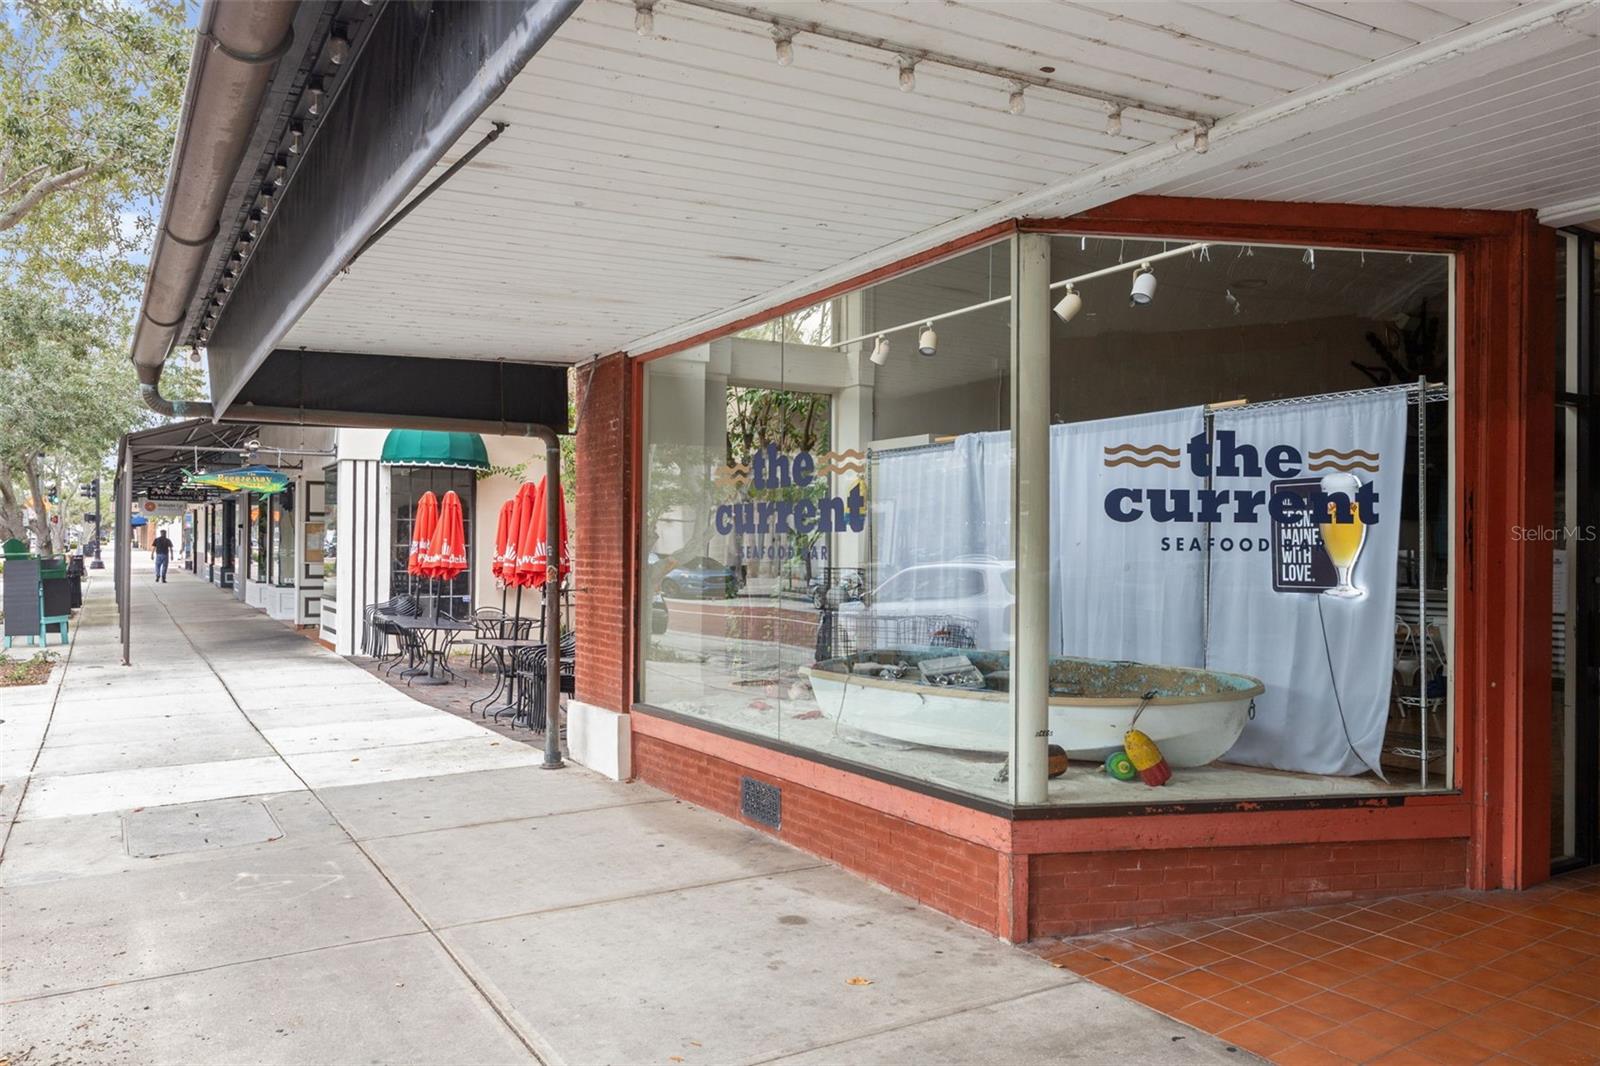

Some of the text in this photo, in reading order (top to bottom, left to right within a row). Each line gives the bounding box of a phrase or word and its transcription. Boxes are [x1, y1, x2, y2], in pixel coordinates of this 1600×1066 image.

[1187, 430, 1302, 478] the
[753, 442, 814, 489] the
[715, 482, 866, 535] current
[1104, 480, 1380, 525] current
[1161, 537, 1270, 552] SEAFOOD
[1281, 528, 1323, 545] MAINE.
[737, 545, 795, 560] SEAFOOD
[1281, 547, 1312, 563] WITH
[1282, 564, 1316, 582] LOVE.
